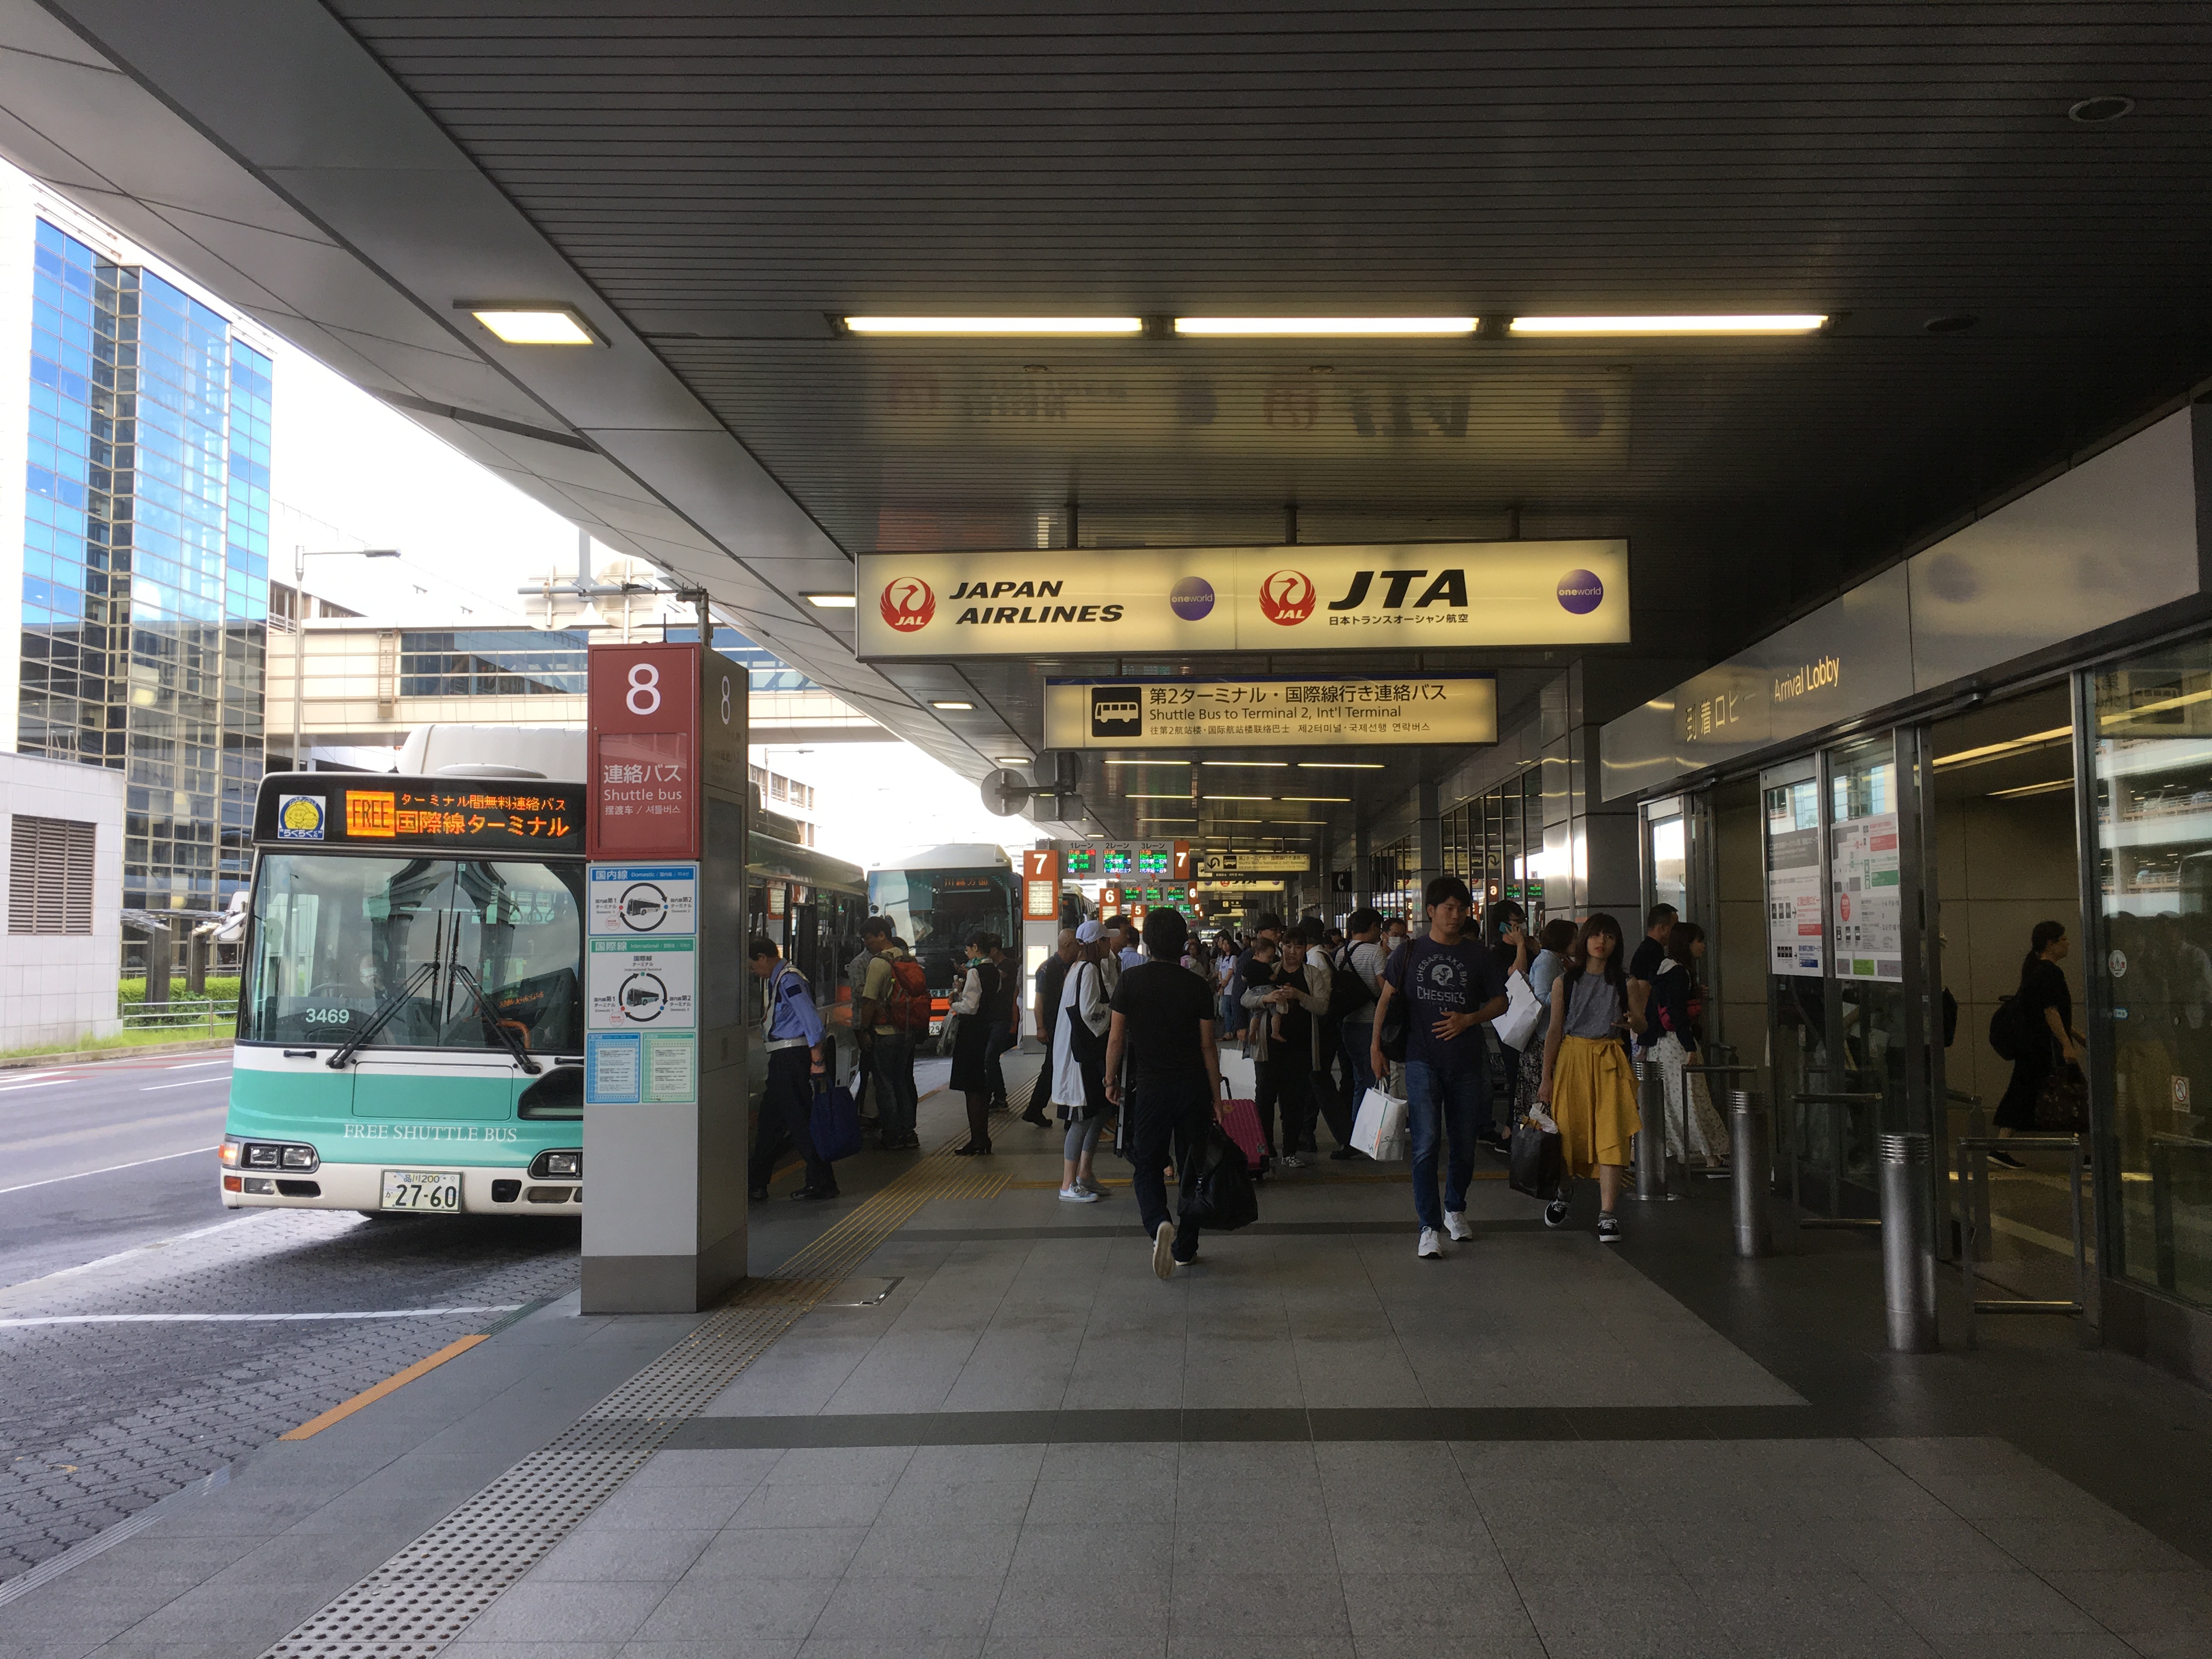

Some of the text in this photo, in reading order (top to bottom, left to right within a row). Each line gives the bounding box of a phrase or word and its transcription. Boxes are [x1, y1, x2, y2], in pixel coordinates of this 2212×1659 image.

[949, 580, 1063, 600] JAPAN
[1172, 594, 1212, 602] oneworld
[1327, 569, 1468, 611] JTA
[1559, 587, 1601, 596] oneworld
[895, 615, 925, 625] JAL
[955, 605, 1124, 624] AIRLINES
[1274, 610, 1305, 619] JAL
[1329, 614, 1469, 625] 日本トランスオーシャン航空
[1775, 655, 1839, 704] Arrival Lobby
[626, 663, 661, 715] 8
[1150, 684, 1447, 704] 第2ターミナル・国際線行き連絡バス
[721, 675, 730, 725] 8
[1150, 706, 1401, 720] Shuttle Bus to Terminal 2, Int'l Terminal
[1686, 685, 1756, 742] 到着ロビー
[1392, 722, 1430, 732] 연락버스
[603, 764, 682, 784] 連絡バス
[401, 794, 566, 811] ターミナル間無料連絡バス
[604, 788, 682, 801] Shuttle bus
[353, 799, 390, 828] FREE
[605, 805, 634, 815] 摆渡车
[646, 805, 681, 814] 셔틀버스
[396, 810, 569, 837] 国際線ターミナル
[1034, 854, 1047, 874] 7
[1176, 853, 1187, 867] 7
[596, 870, 628, 880] 国内線
[1105, 890, 1114, 903] 6
[1189, 888, 1196, 898] 6
[1135, 906, 1142, 915] 5
[595, 941, 627, 951] 国際線
[1417, 954, 1464, 982] CHESAPEAKE
[1417, 986, 1466, 1005] CHESSIES
[306, 1008, 349, 1024] 3469
[343, 1124, 517, 1142] FREE SHUTTLE BUS
[404, 1174, 439, 1183] 品川200
[395, 1184, 456, 1207] 27-60
